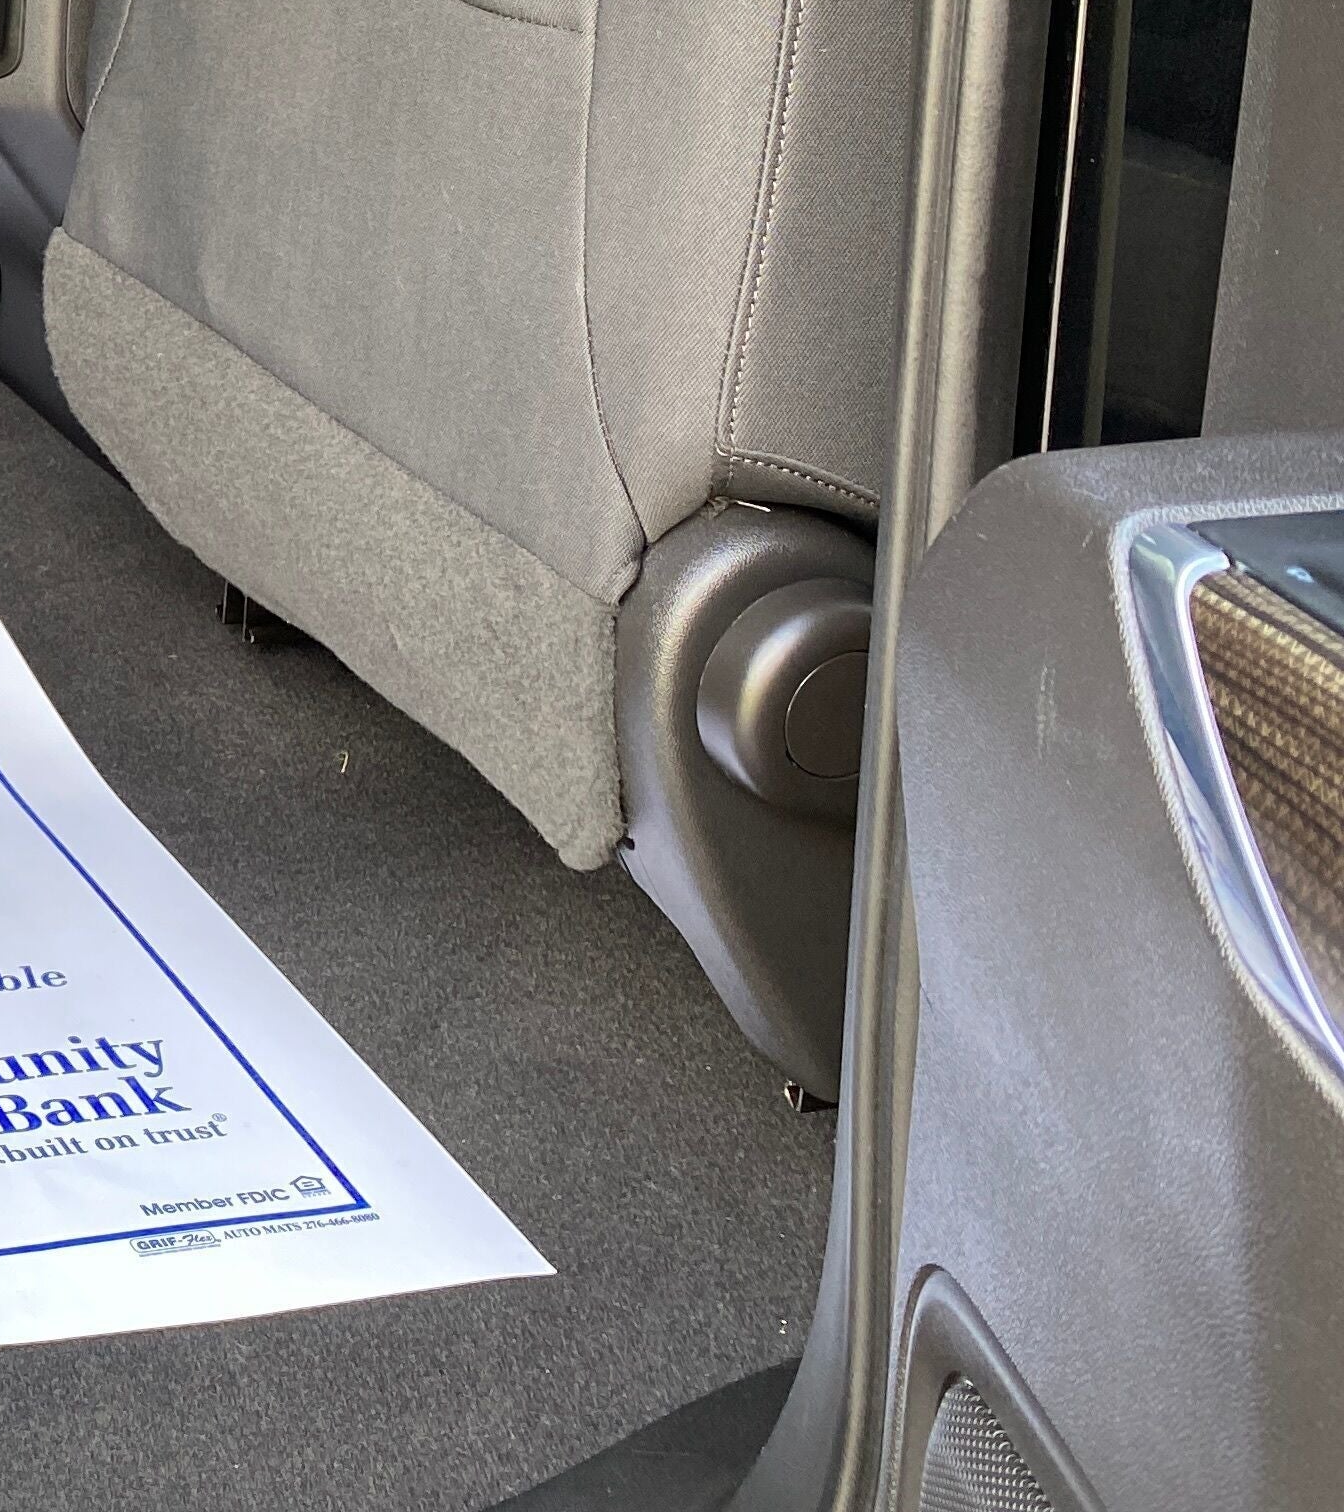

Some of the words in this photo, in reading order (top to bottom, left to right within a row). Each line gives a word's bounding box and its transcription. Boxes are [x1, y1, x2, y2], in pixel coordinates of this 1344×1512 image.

[94, 1133, 141, 1151] on
[139, 1195, 234, 1216] Member
[236, 1188, 291, 1206] FDIC
[223, 1226, 262, 1239] AUTO
[262, 1221, 302, 1235] MATS
